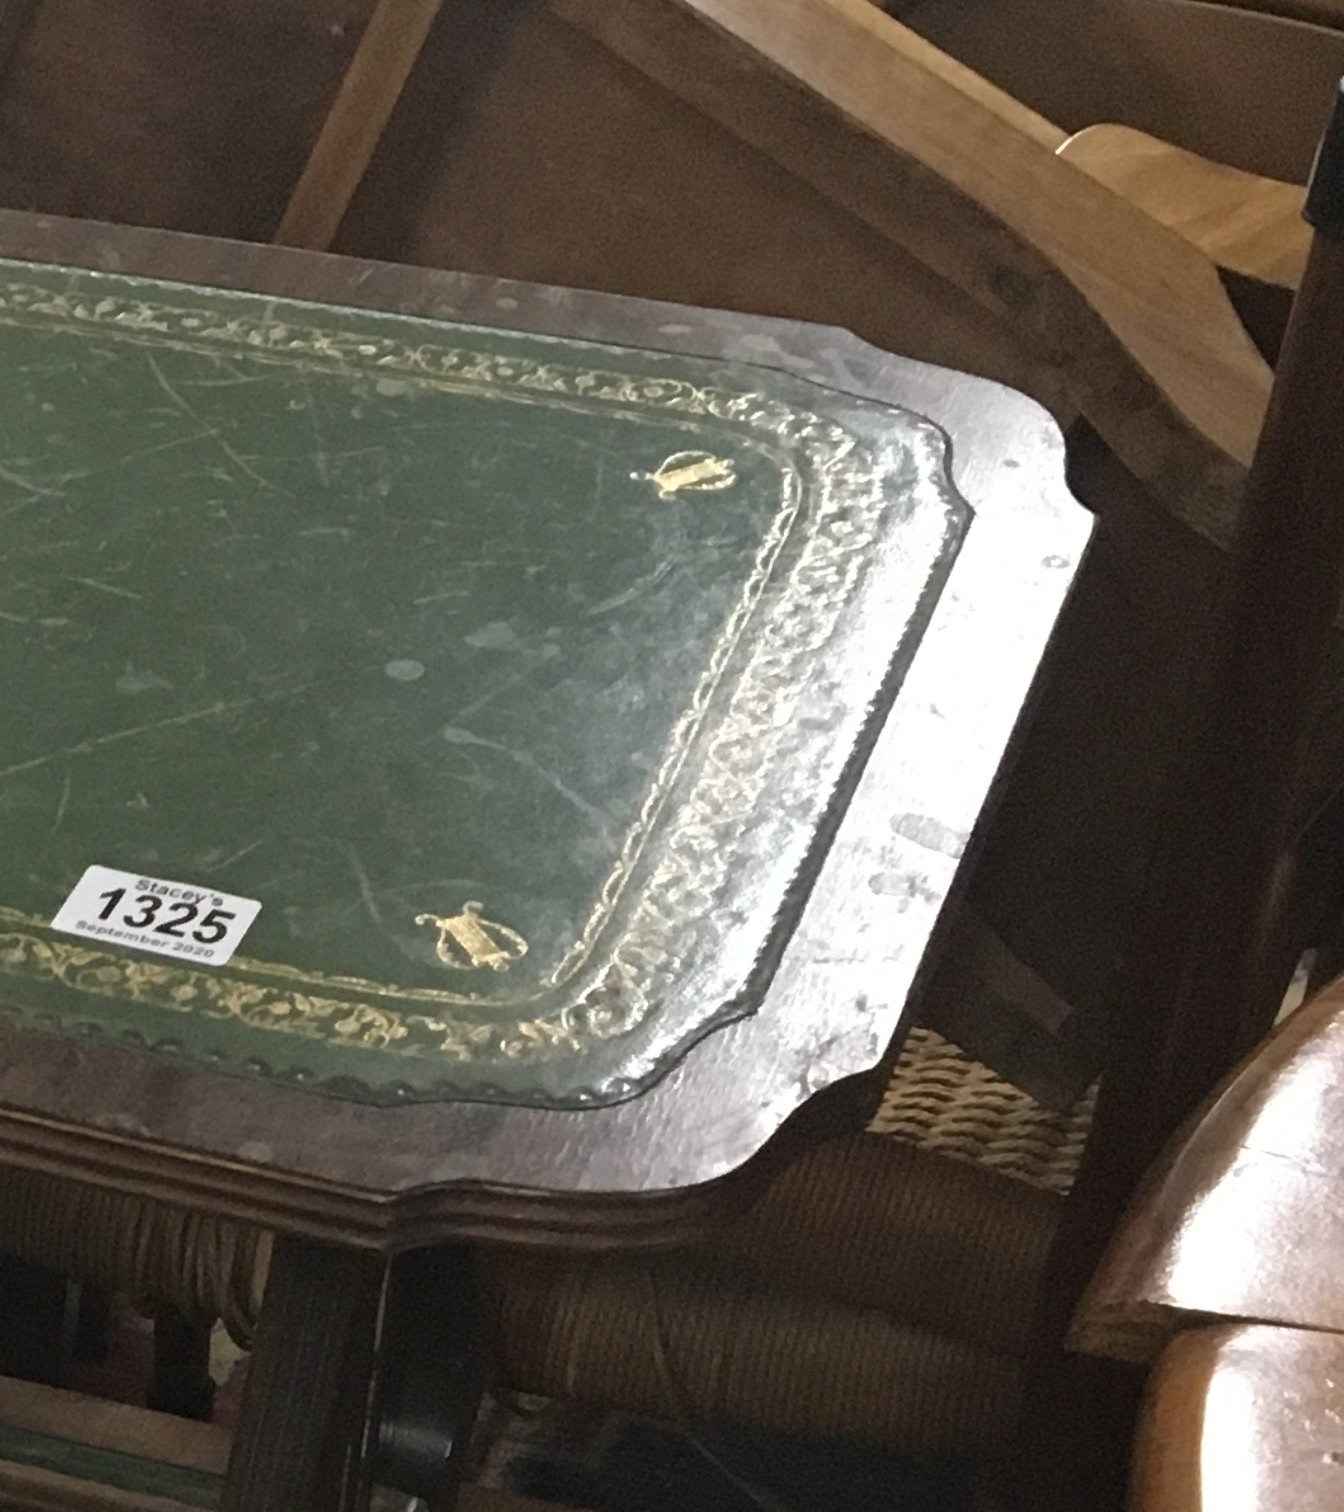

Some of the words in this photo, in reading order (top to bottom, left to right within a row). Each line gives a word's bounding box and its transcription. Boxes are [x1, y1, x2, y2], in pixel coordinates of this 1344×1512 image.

[135, 879, 224, 907] Stacey's
[98, 887, 237, 944] 1325
[75, 920, 169, 948] September
[172, 942, 215, 958] 2020
